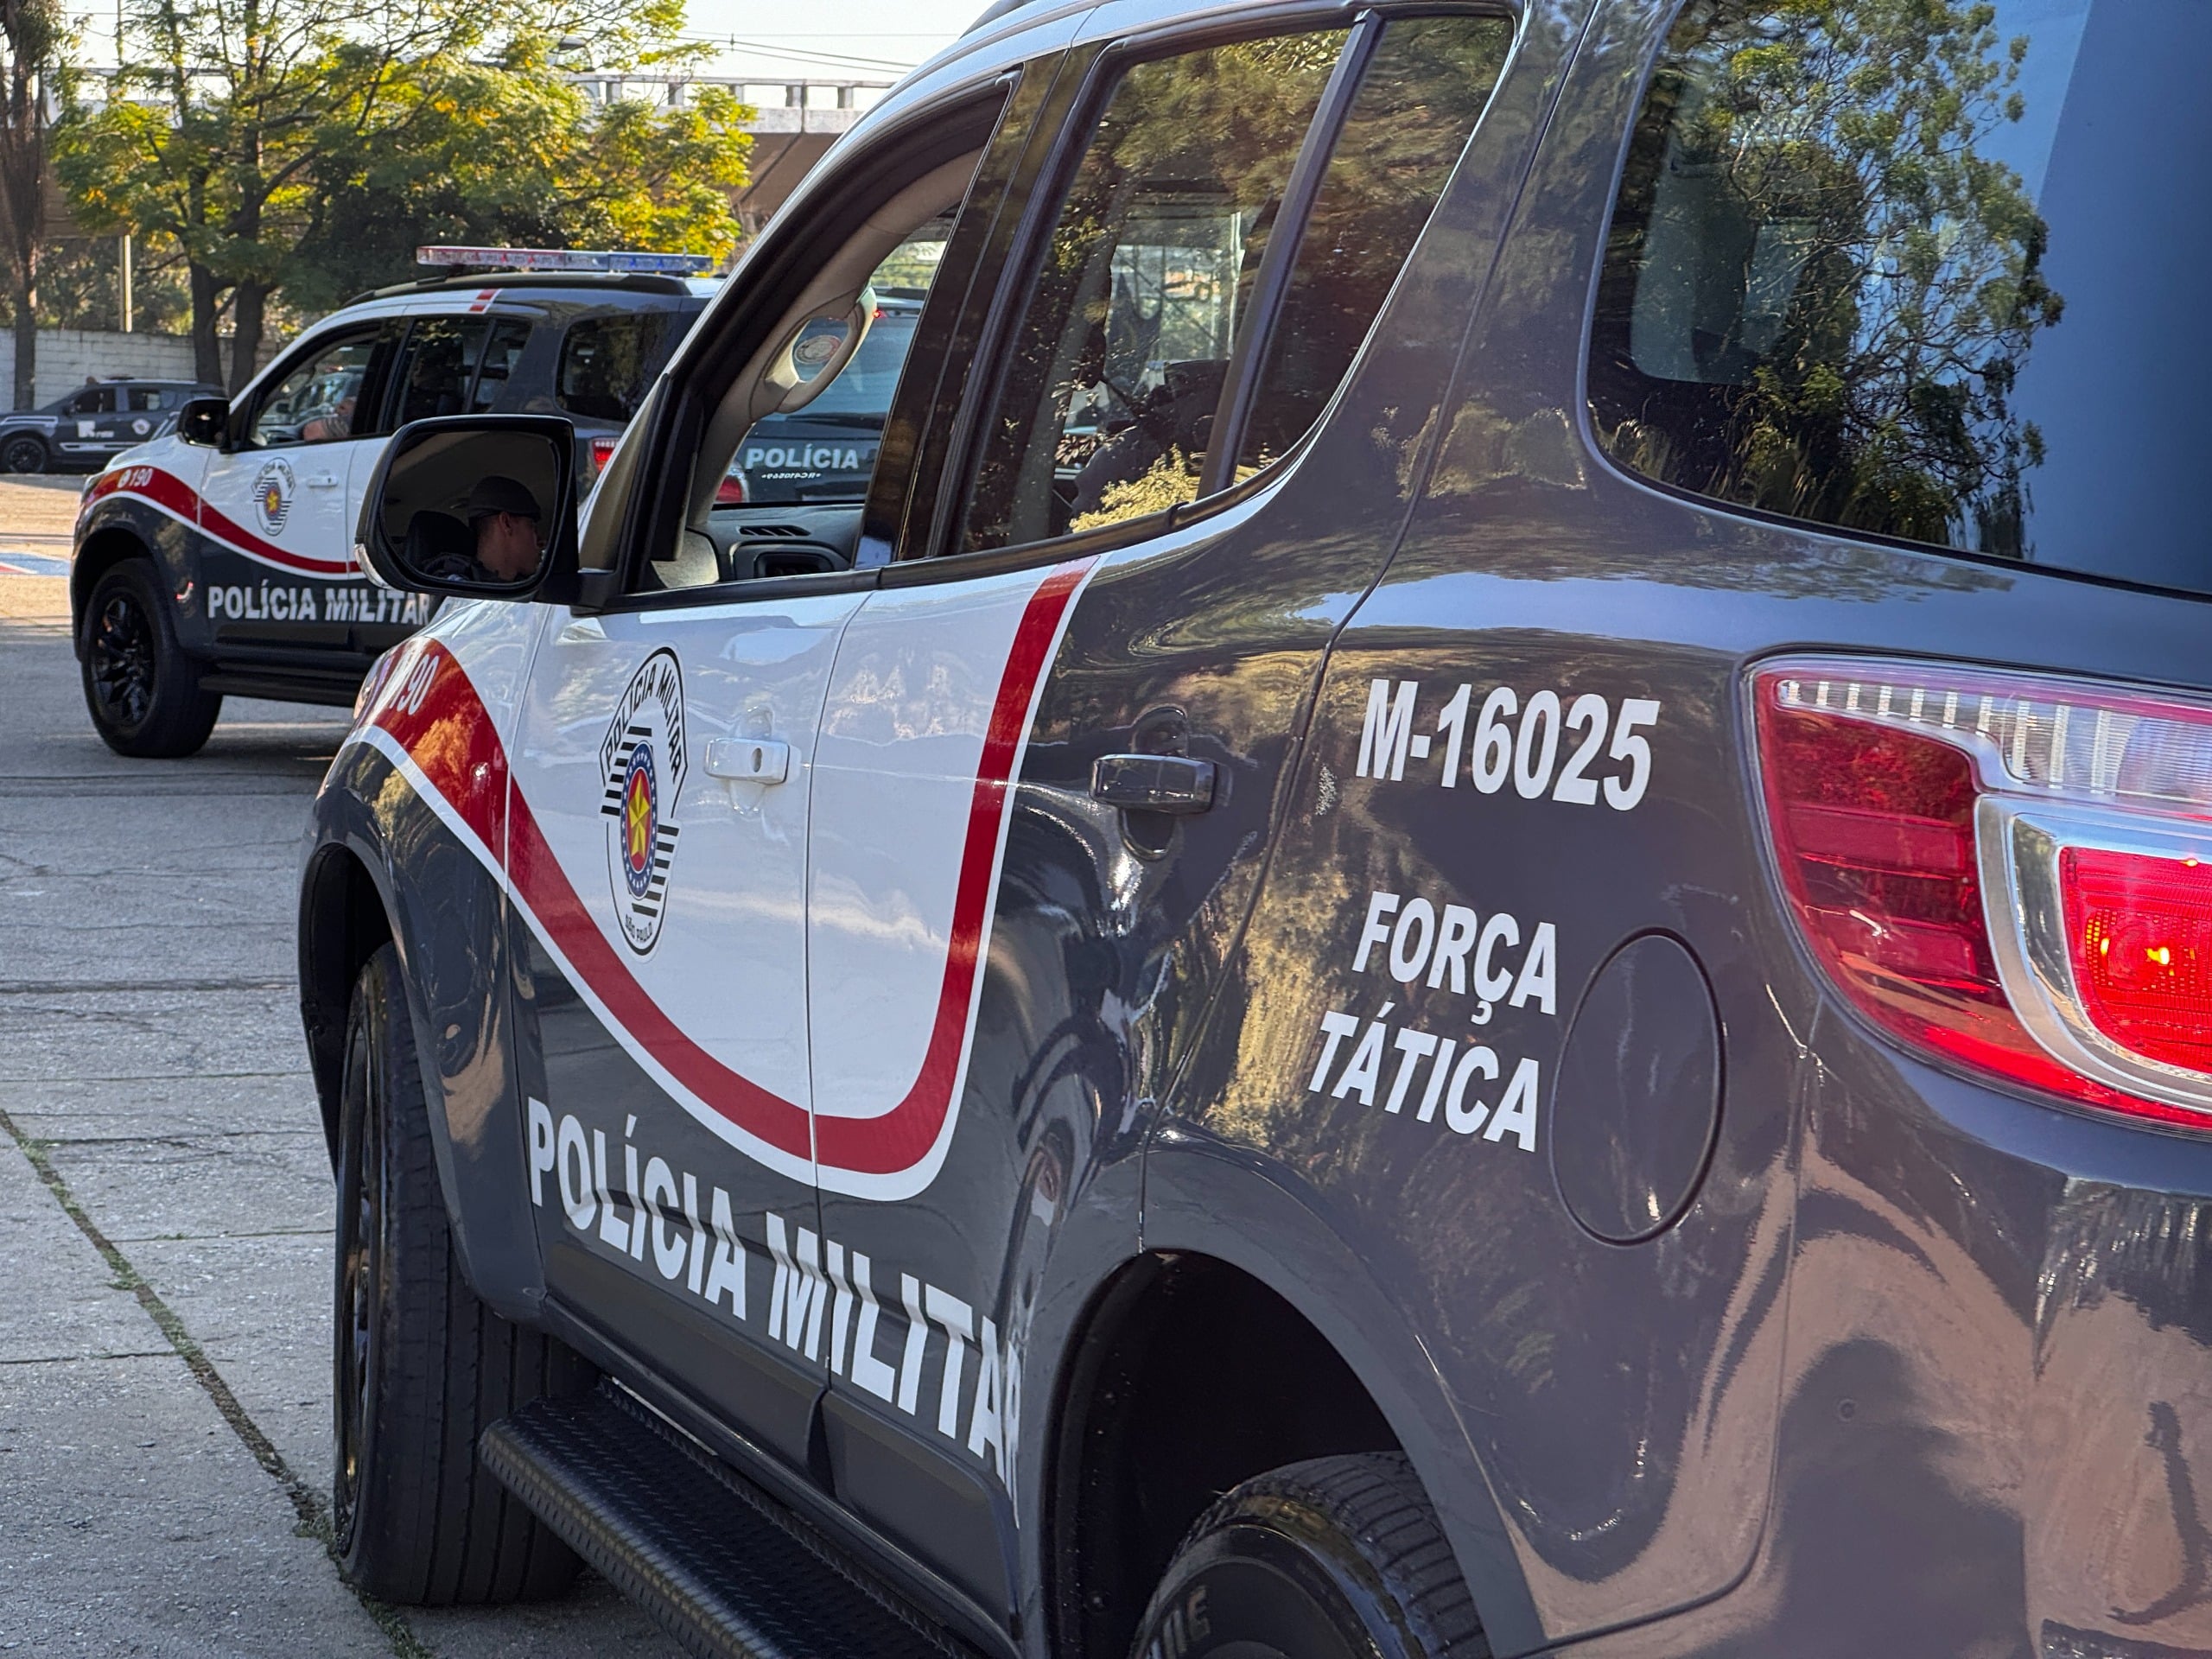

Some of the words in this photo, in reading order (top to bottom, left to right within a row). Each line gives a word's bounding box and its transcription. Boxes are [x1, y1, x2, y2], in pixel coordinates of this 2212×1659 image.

[129, 467, 154, 487] 190
[745, 443, 859, 469] POLÍCIA
[207, 579, 317, 620] POLÍCIA
[324, 588, 431, 626] MILITAR
[656, 663, 683, 785] MILITAR
[1355, 678, 1661, 811] M-16025
[1351, 890, 1556, 1025] FORÇA
[1308, 1001, 1540, 1152] TÁTICA
[528, 1096, 747, 1321] POLÍCIA
